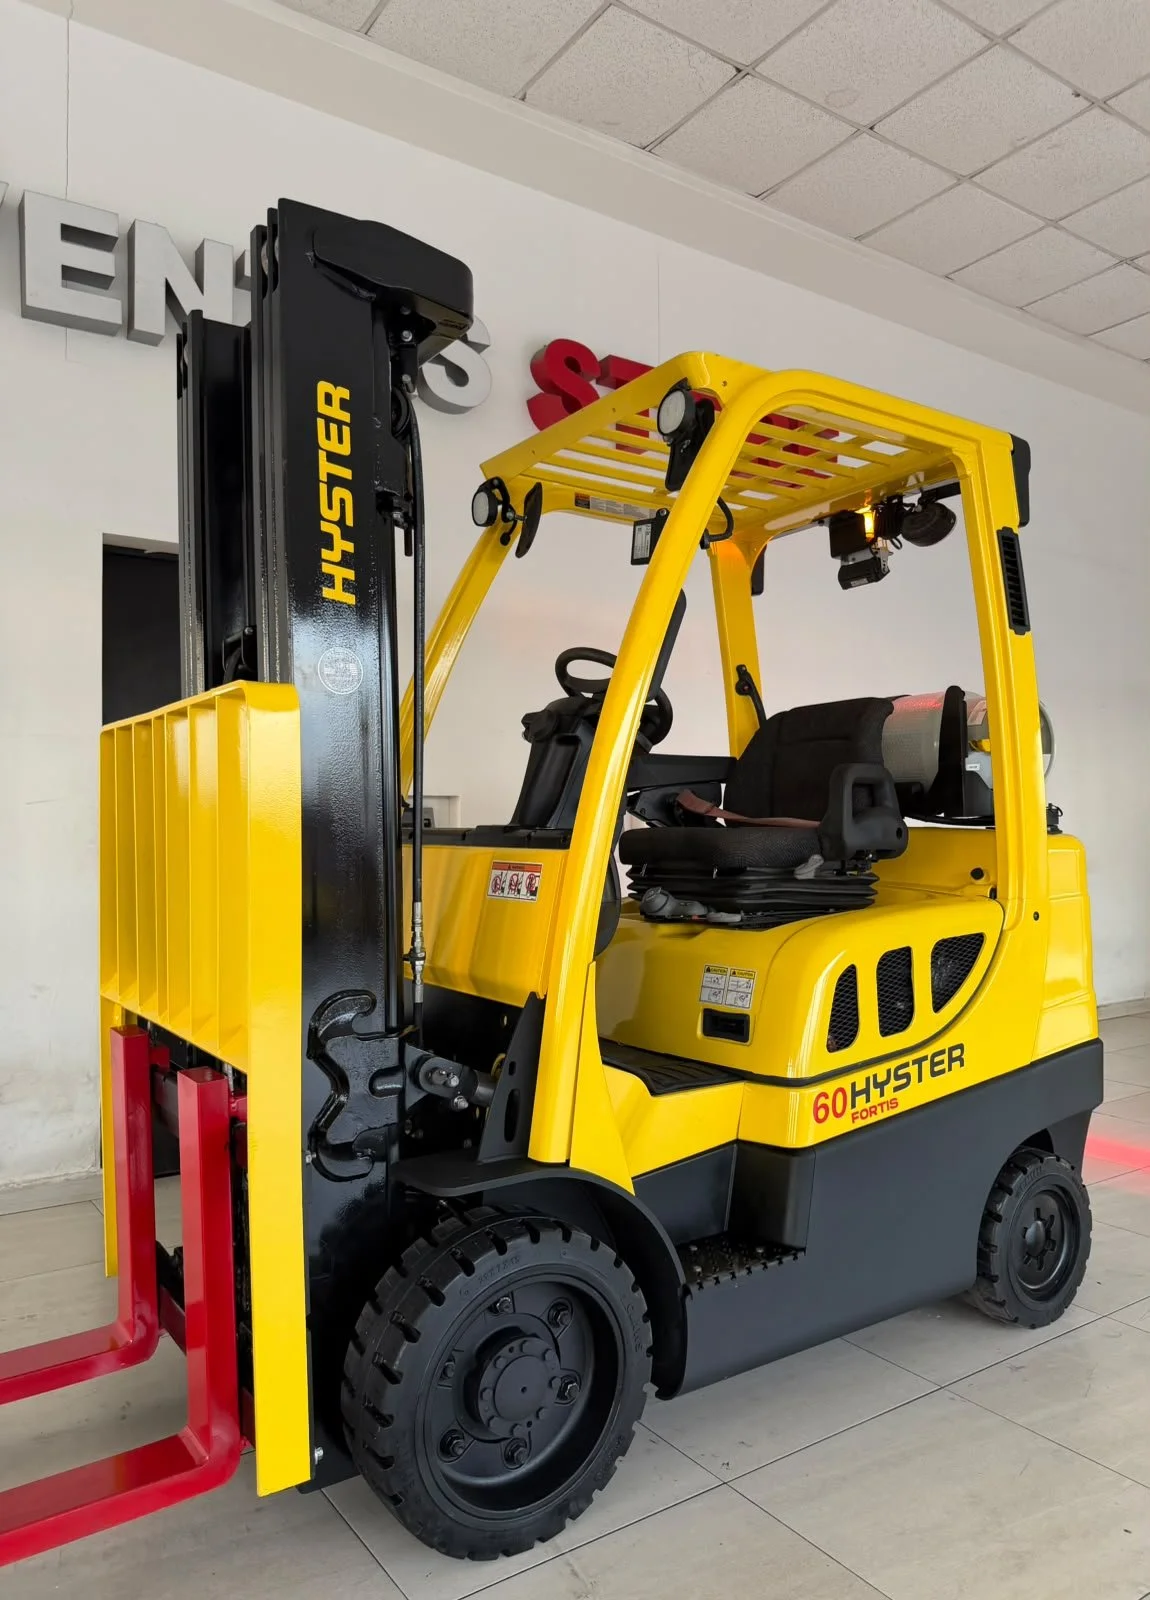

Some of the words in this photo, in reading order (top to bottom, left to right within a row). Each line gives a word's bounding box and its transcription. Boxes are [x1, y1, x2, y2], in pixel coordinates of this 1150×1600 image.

[316, 380, 356, 606] HYSTER
[813, 1086, 848, 1124] 60
[850, 1042, 965, 1110] HYSTER
[851, 1098, 899, 1124] FORTIS
